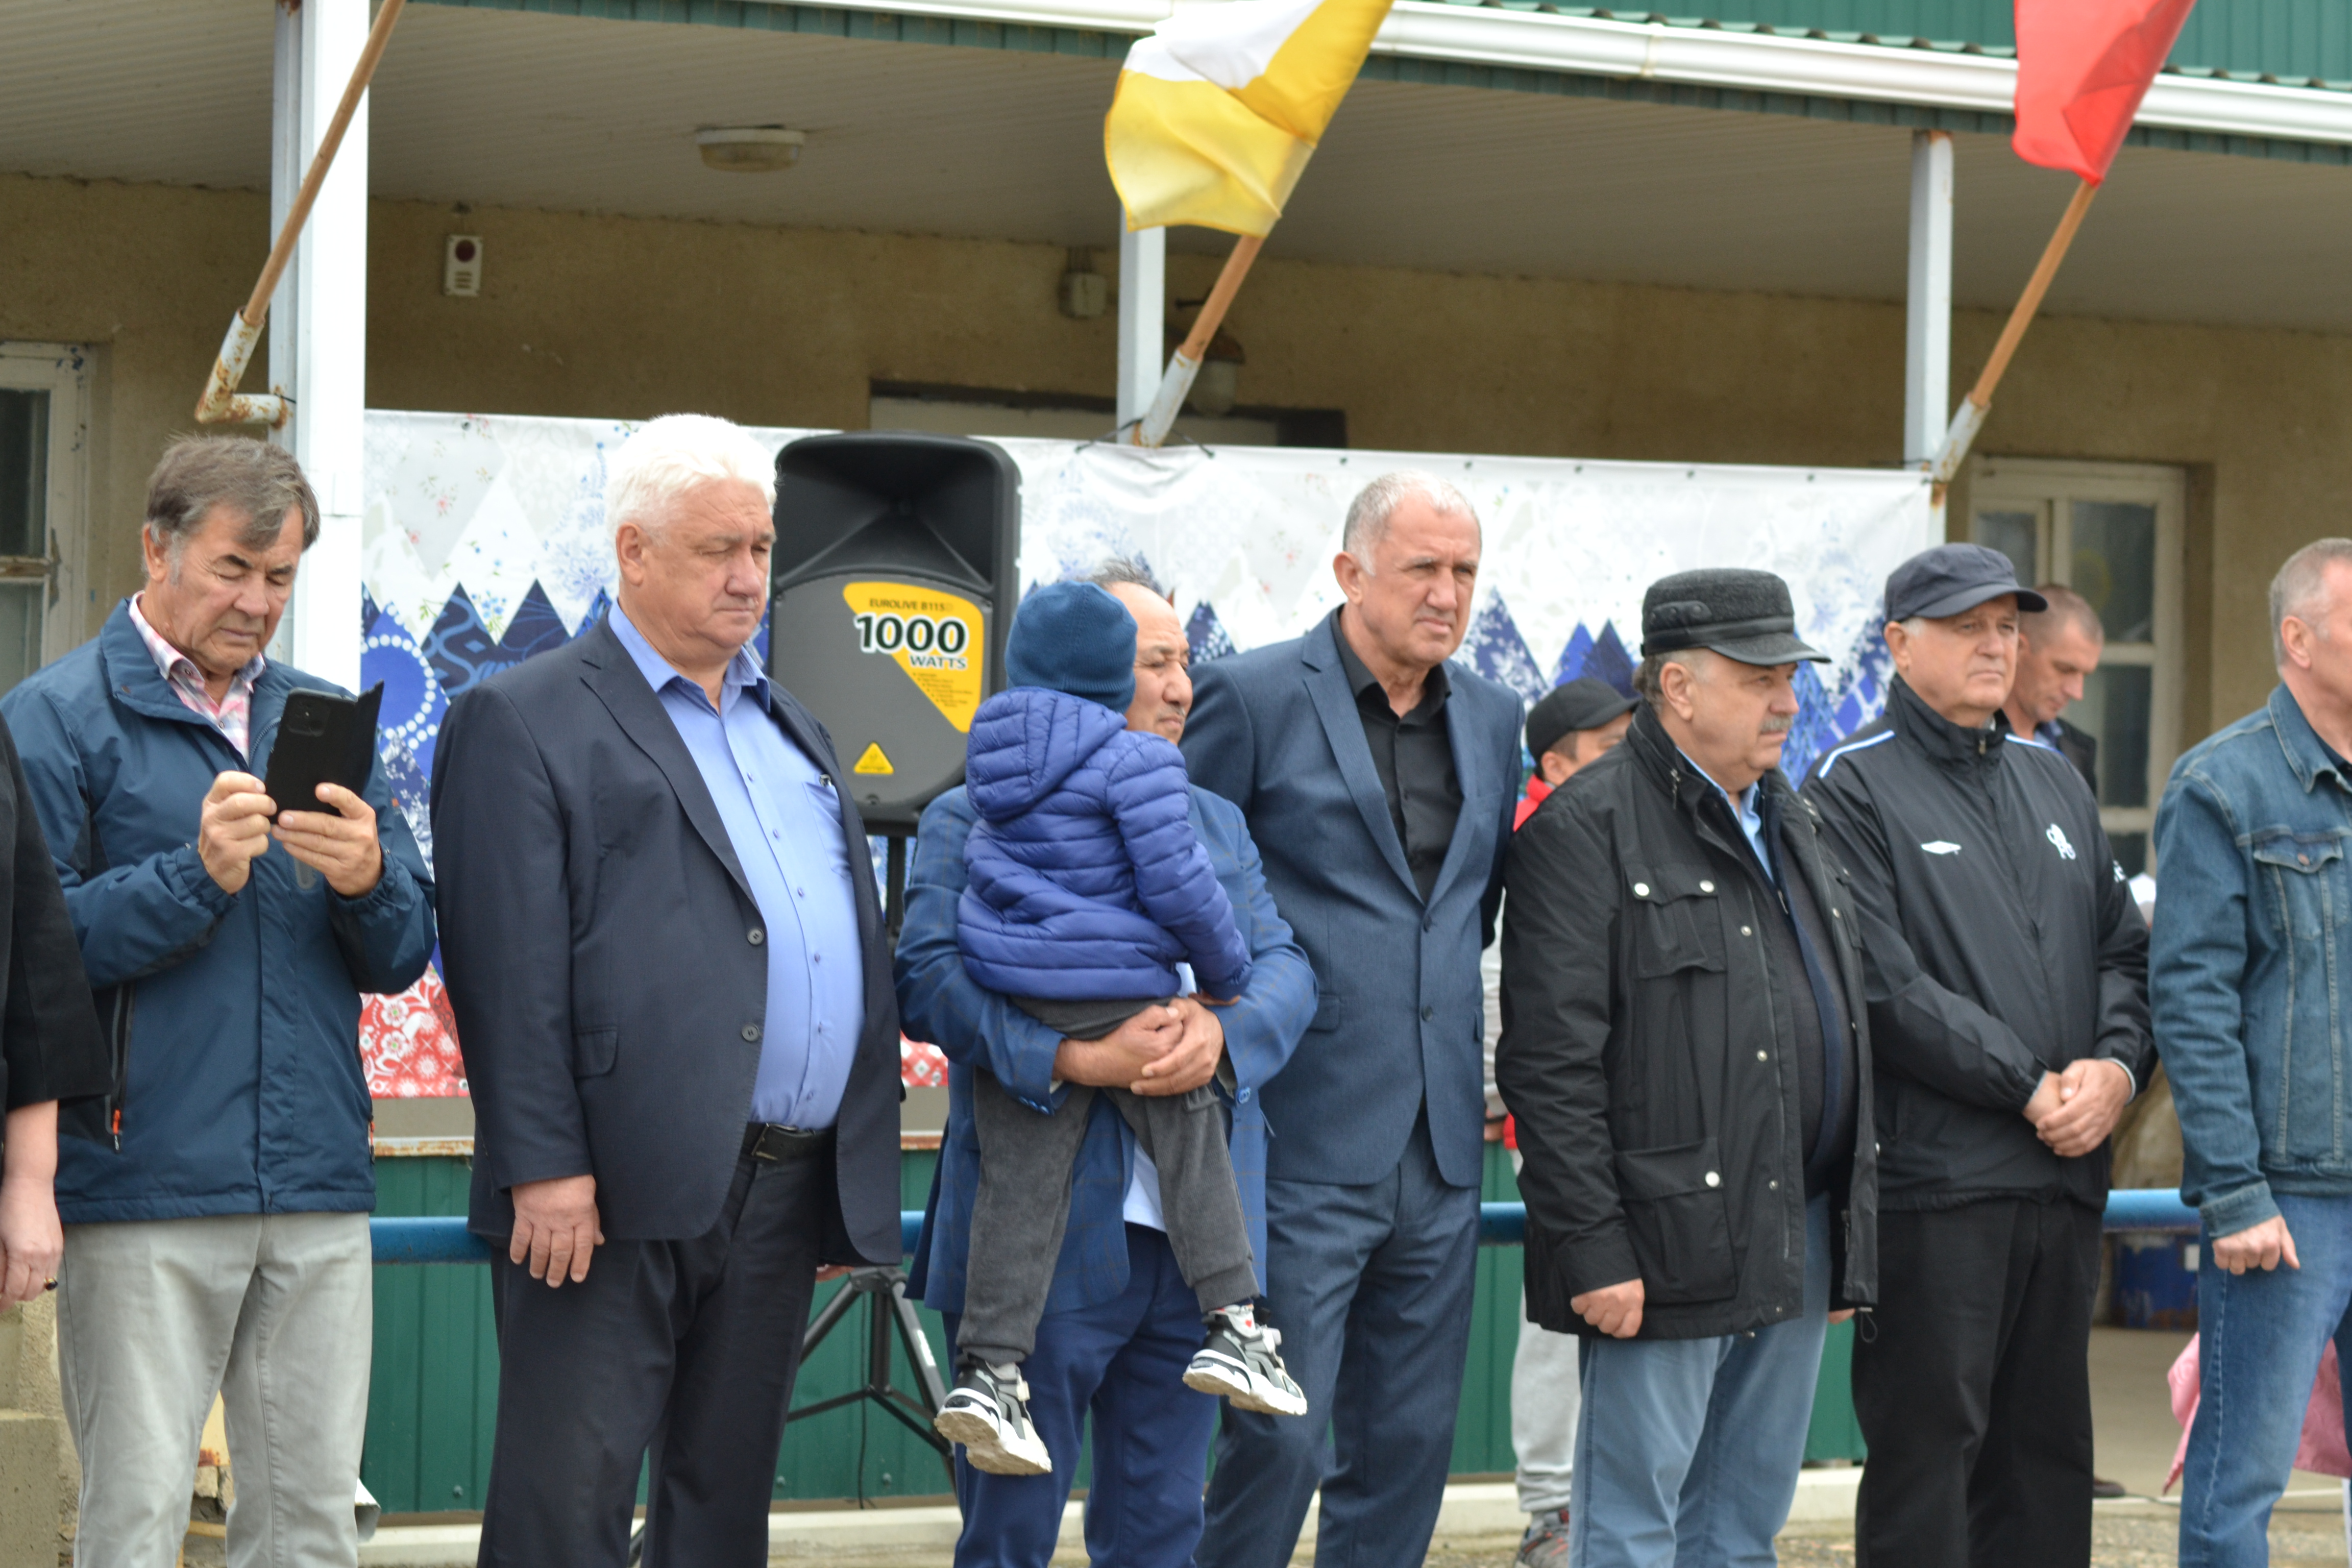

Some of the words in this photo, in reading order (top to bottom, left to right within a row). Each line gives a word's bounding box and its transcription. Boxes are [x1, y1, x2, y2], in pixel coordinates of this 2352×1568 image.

[869, 598, 917, 610] EUROLIVE
[856, 616, 965, 653] 1000
[910, 655, 966, 669] WATTS
